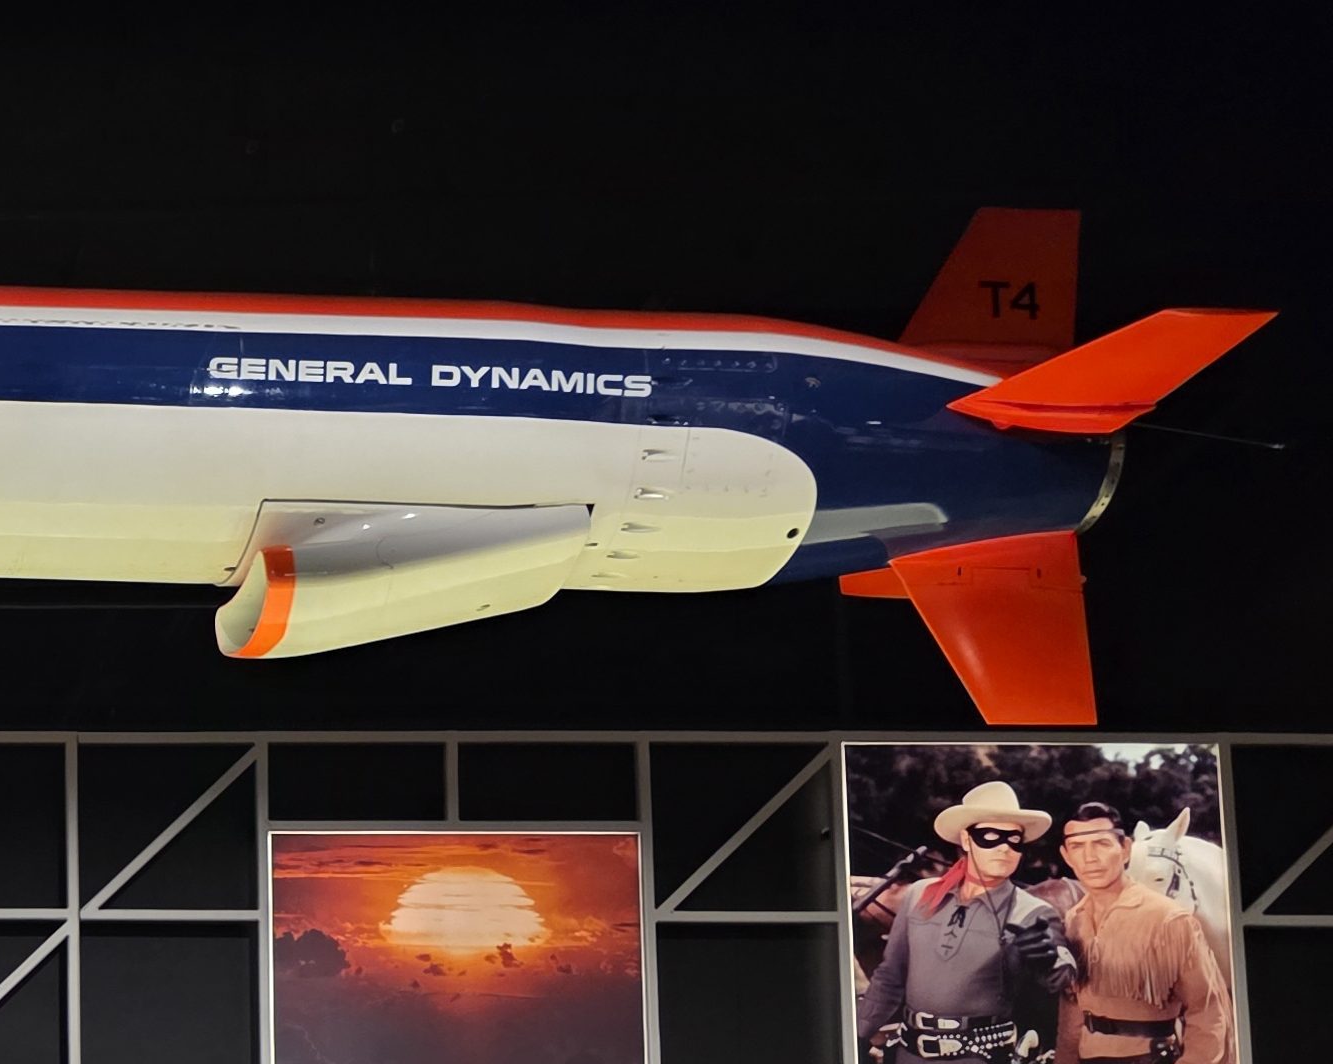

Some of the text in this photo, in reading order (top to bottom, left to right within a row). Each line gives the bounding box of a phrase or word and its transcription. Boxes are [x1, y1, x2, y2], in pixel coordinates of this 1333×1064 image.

[979, 280, 1041, 321] T4
[209, 356, 653, 398] GENERAL DYNAMICS
